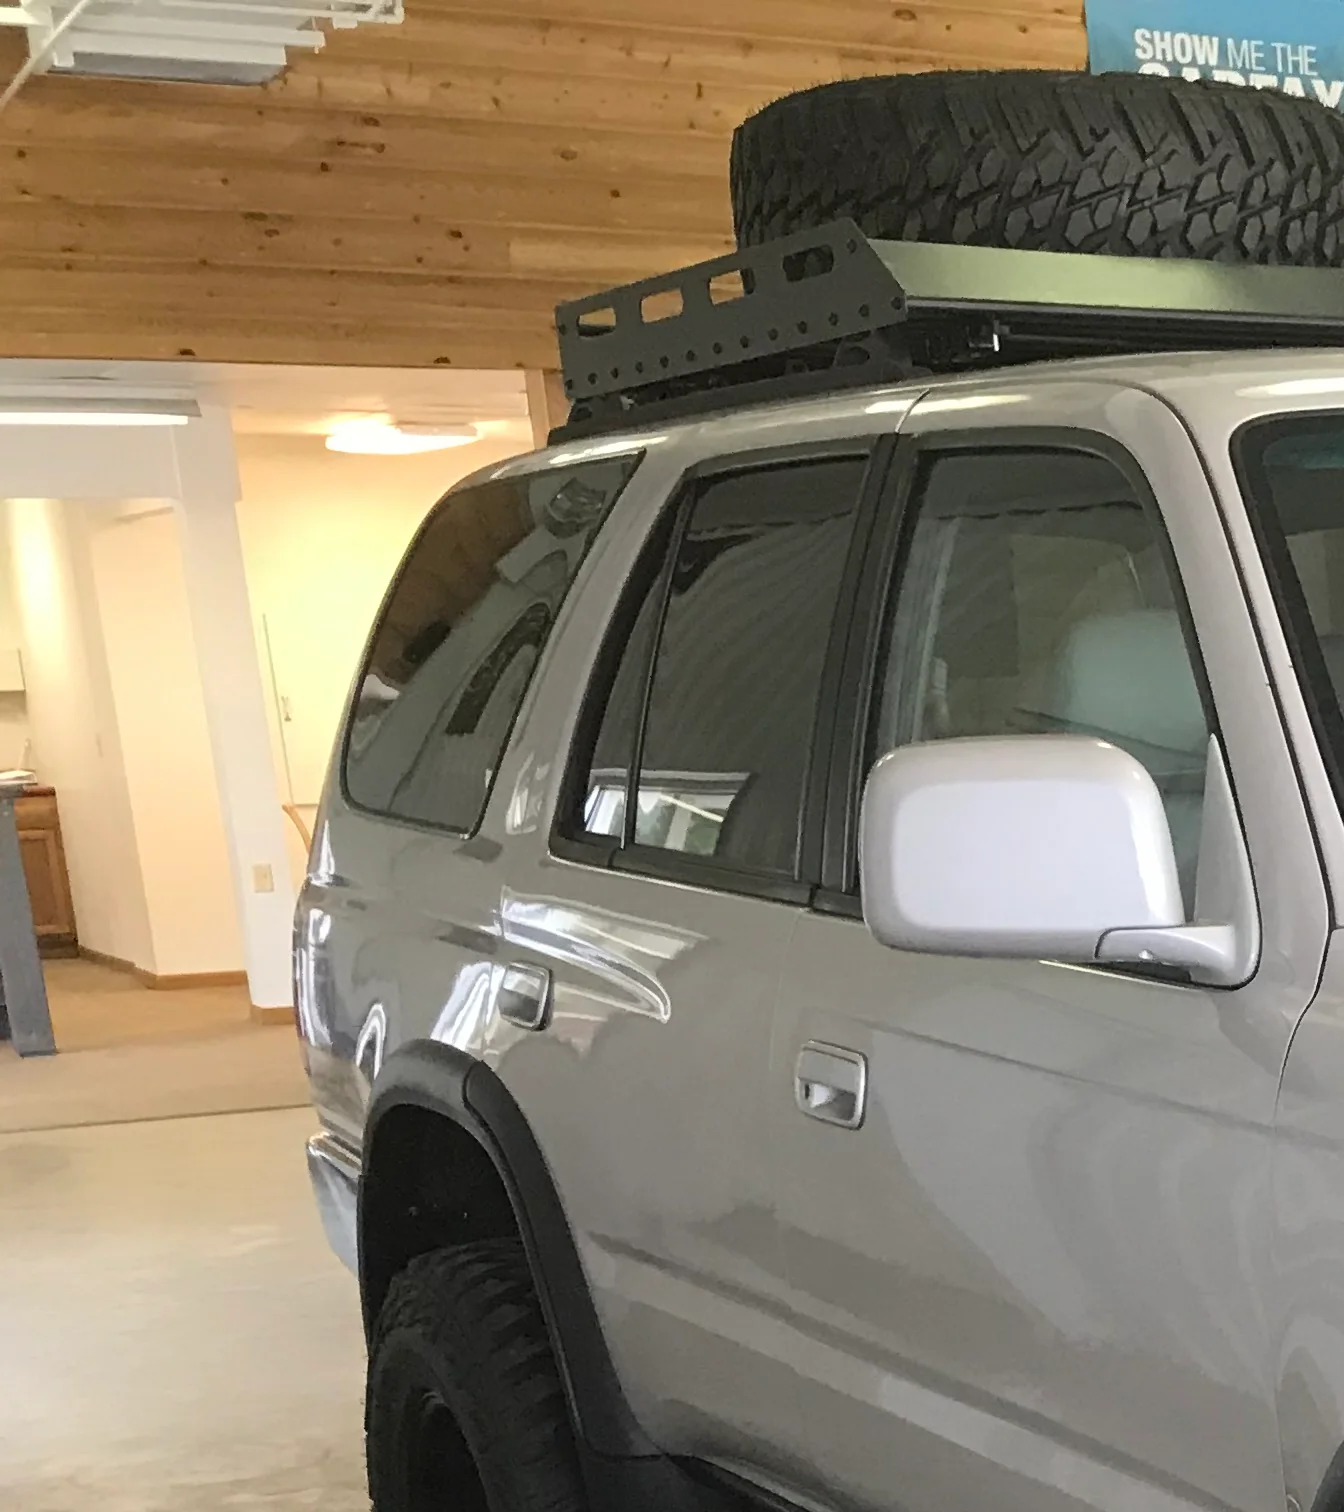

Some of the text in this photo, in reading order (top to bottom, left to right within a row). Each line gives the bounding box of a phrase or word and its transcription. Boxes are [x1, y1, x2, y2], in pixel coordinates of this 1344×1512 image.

[1134, 28, 1319, 76] SHOW ME THE
